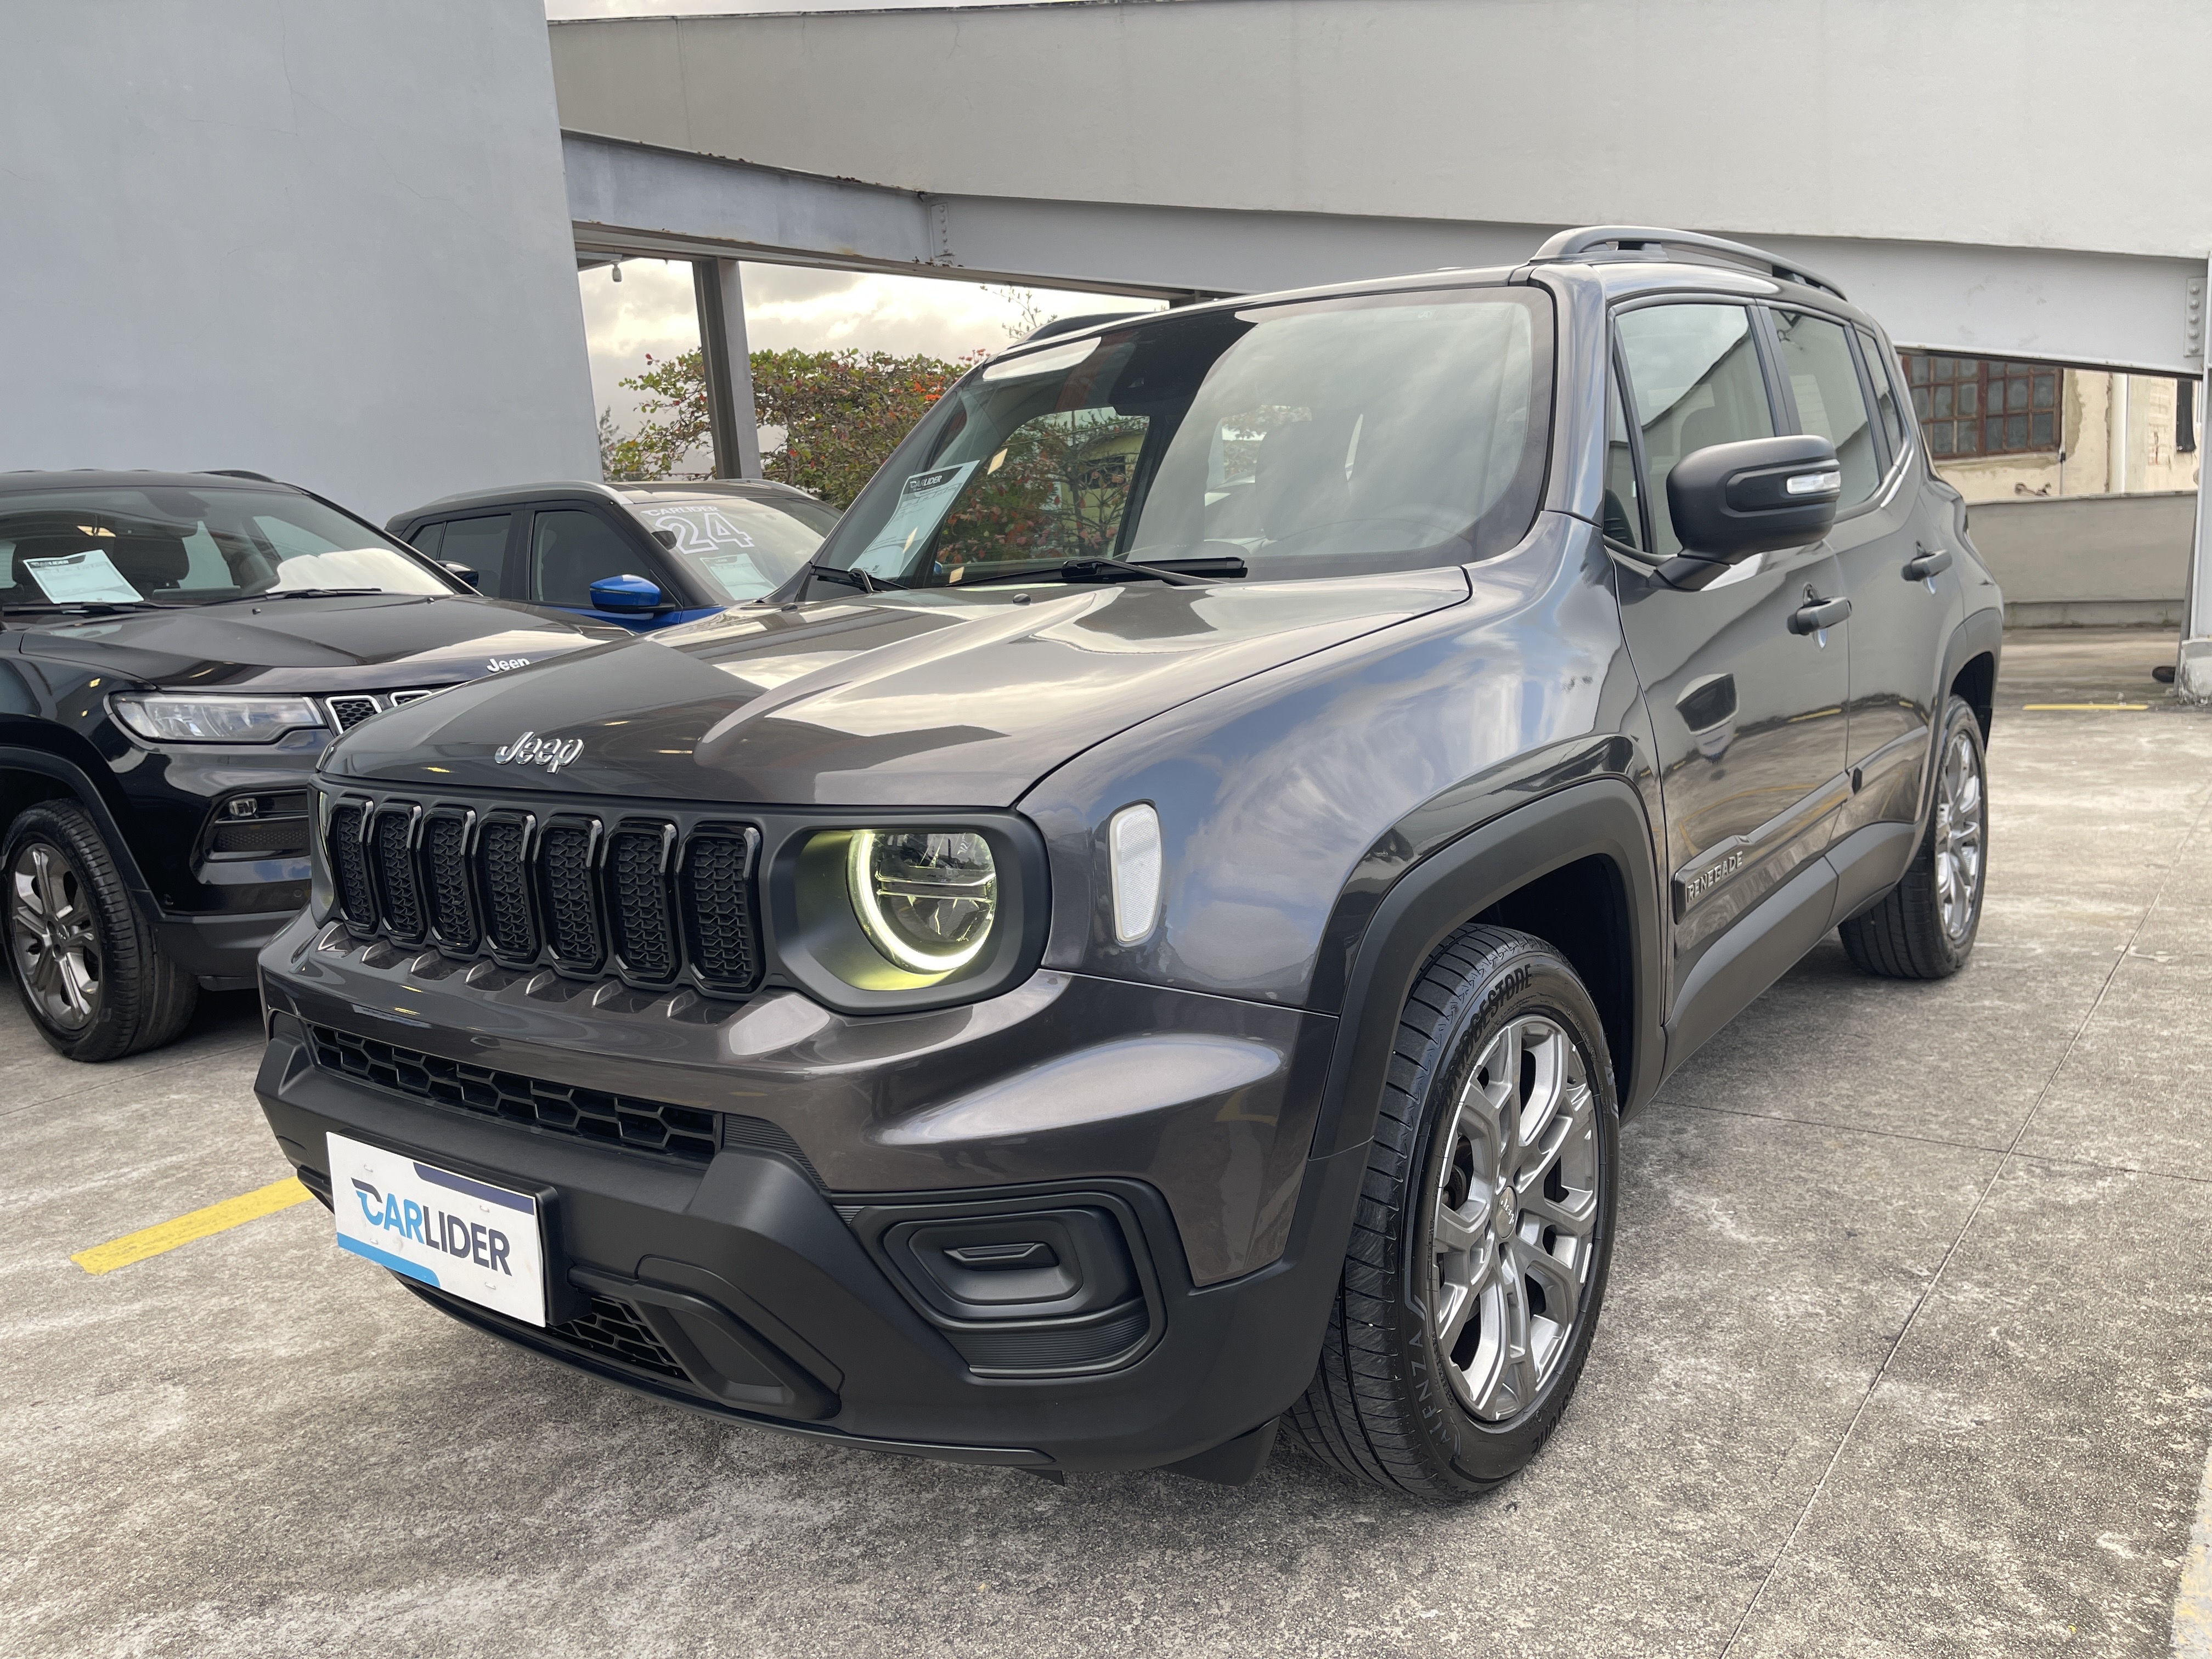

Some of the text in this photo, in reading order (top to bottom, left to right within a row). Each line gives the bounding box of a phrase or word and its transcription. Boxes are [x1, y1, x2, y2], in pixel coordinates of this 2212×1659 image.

[910, 475, 943, 488] CARLIDER
[640, 506, 720, 516] CARLIDER
[655, 512, 755, 555] 24
[495, 731, 585, 774] Jeep
[1687, 851, 1743, 903] RENEGADE
[351, 1177, 512, 1277] CARLIDER
[1409, 1329, 1451, 1446] ALENZA
